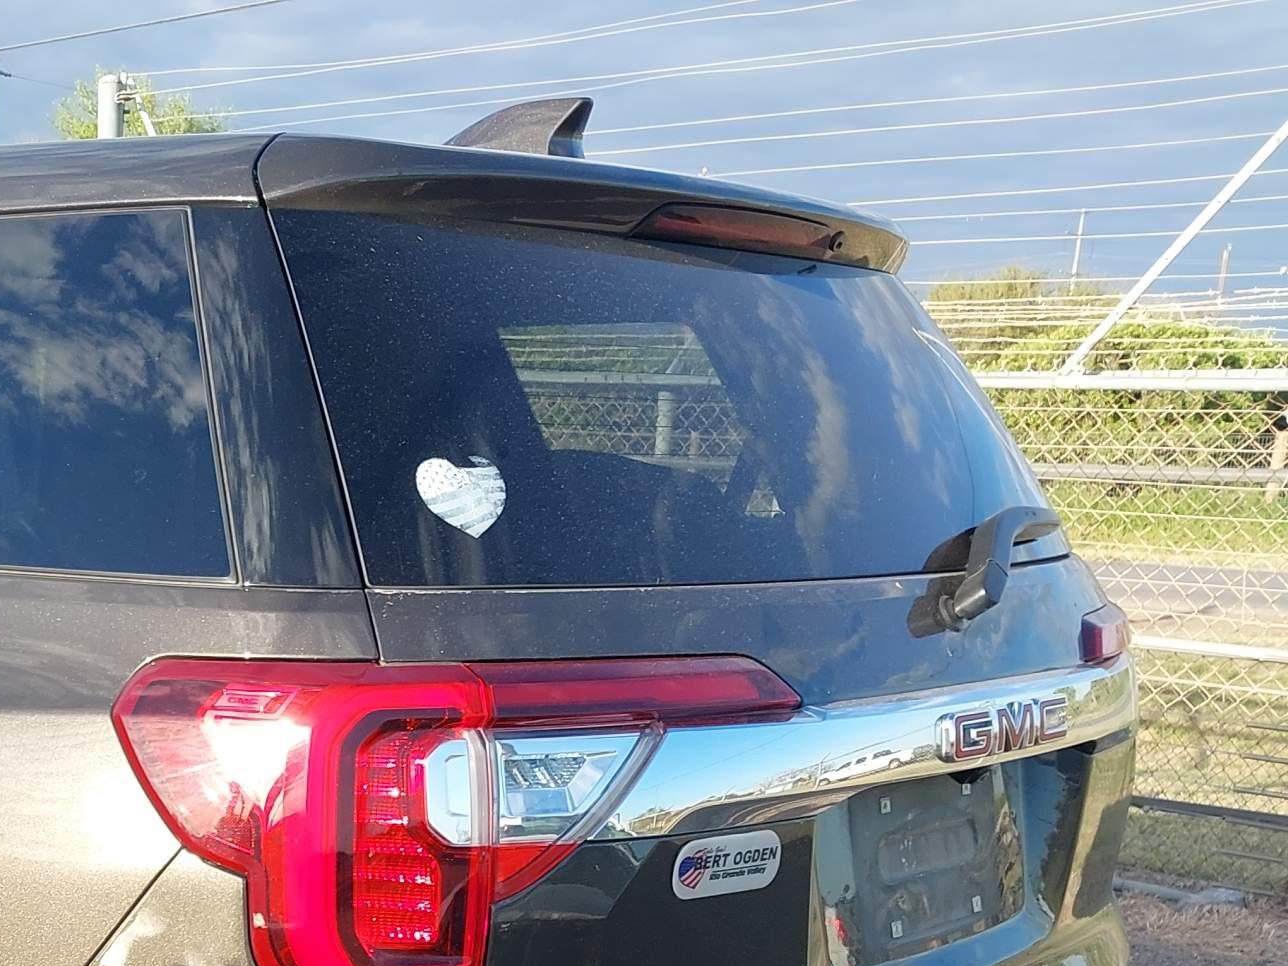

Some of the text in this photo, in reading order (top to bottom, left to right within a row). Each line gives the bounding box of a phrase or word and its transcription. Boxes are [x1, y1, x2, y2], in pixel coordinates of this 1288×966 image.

[954, 695, 1068, 761] GMC
[695, 846, 778, 870] BERT OGDEN
